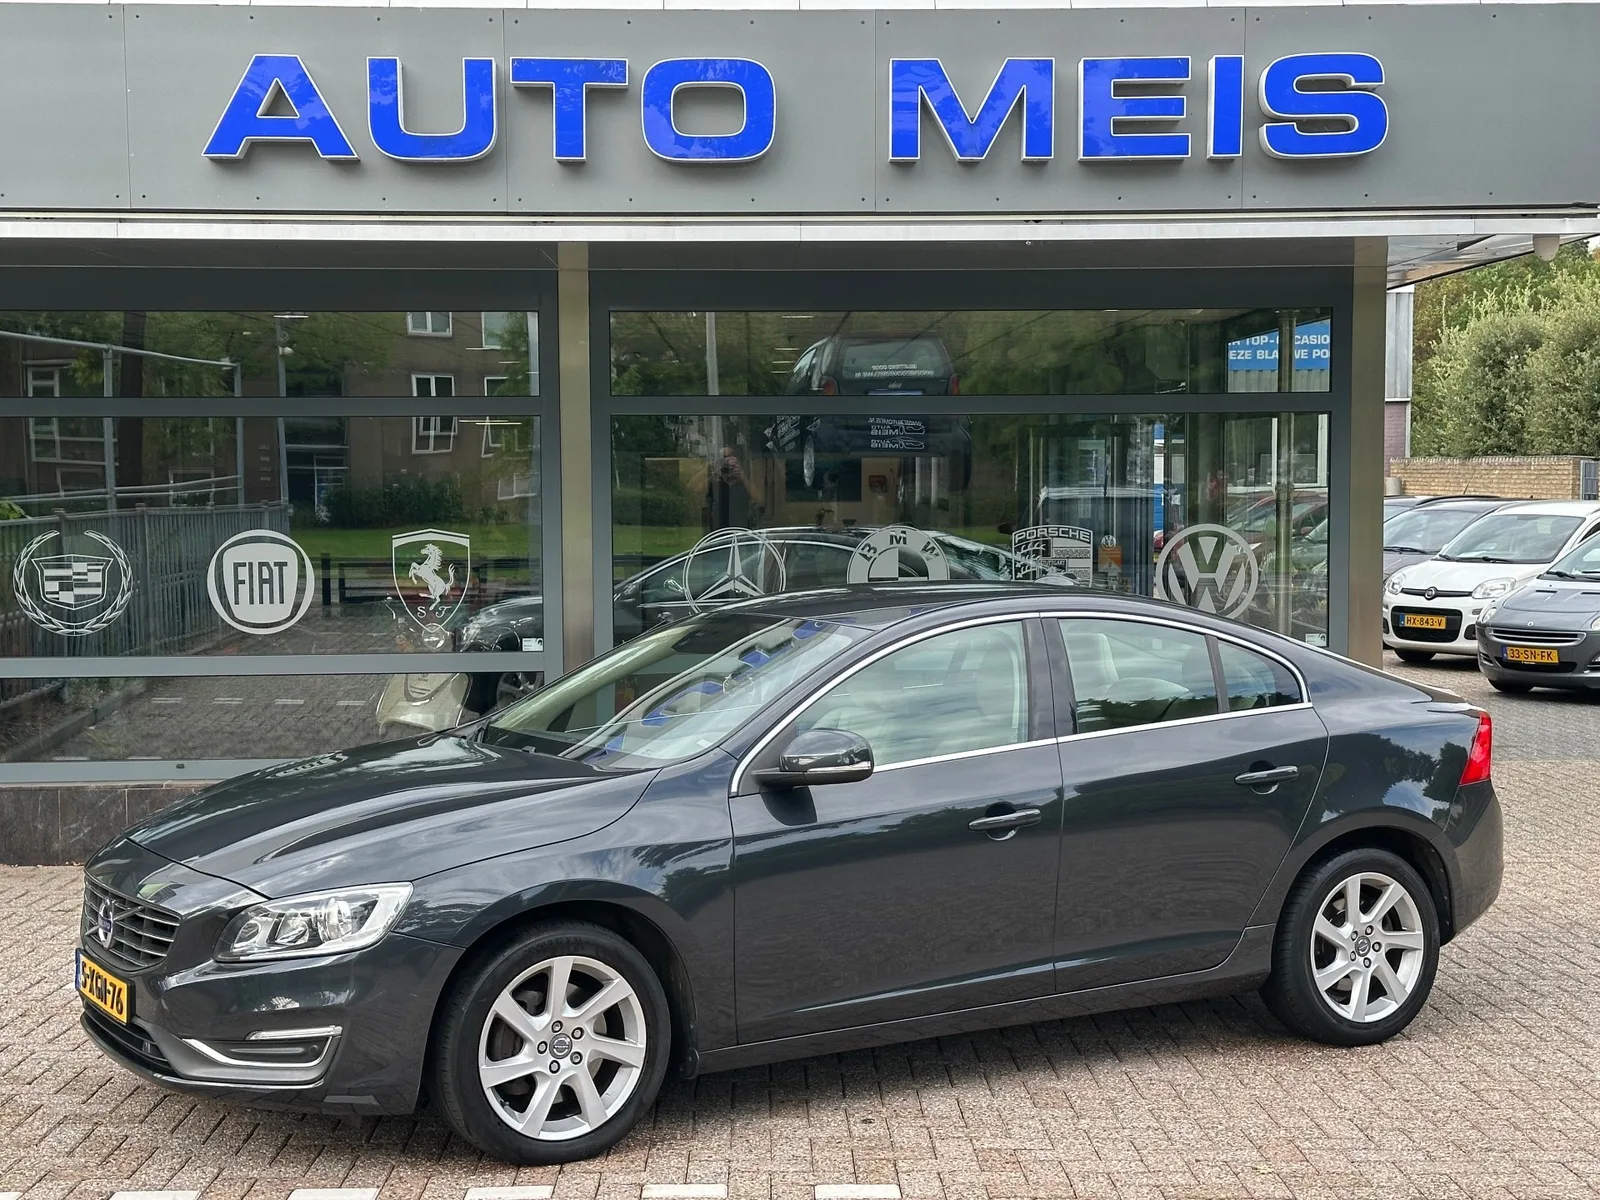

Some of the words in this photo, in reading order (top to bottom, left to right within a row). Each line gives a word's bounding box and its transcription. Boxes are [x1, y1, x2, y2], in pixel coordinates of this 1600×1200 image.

[202, 53, 777, 163] AUTO
[888, 51, 1389, 162] MEIS
[1228, 350, 1252, 360] EZE
[1312, 349, 1330, 359] PO
[1015, 527, 1091, 543] PORSCHE
[233, 561, 288, 605] FIAT
[1406, 615, 1444, 627] HX-843-V
[1509, 648, 1555, 661] 33-SN-FK
